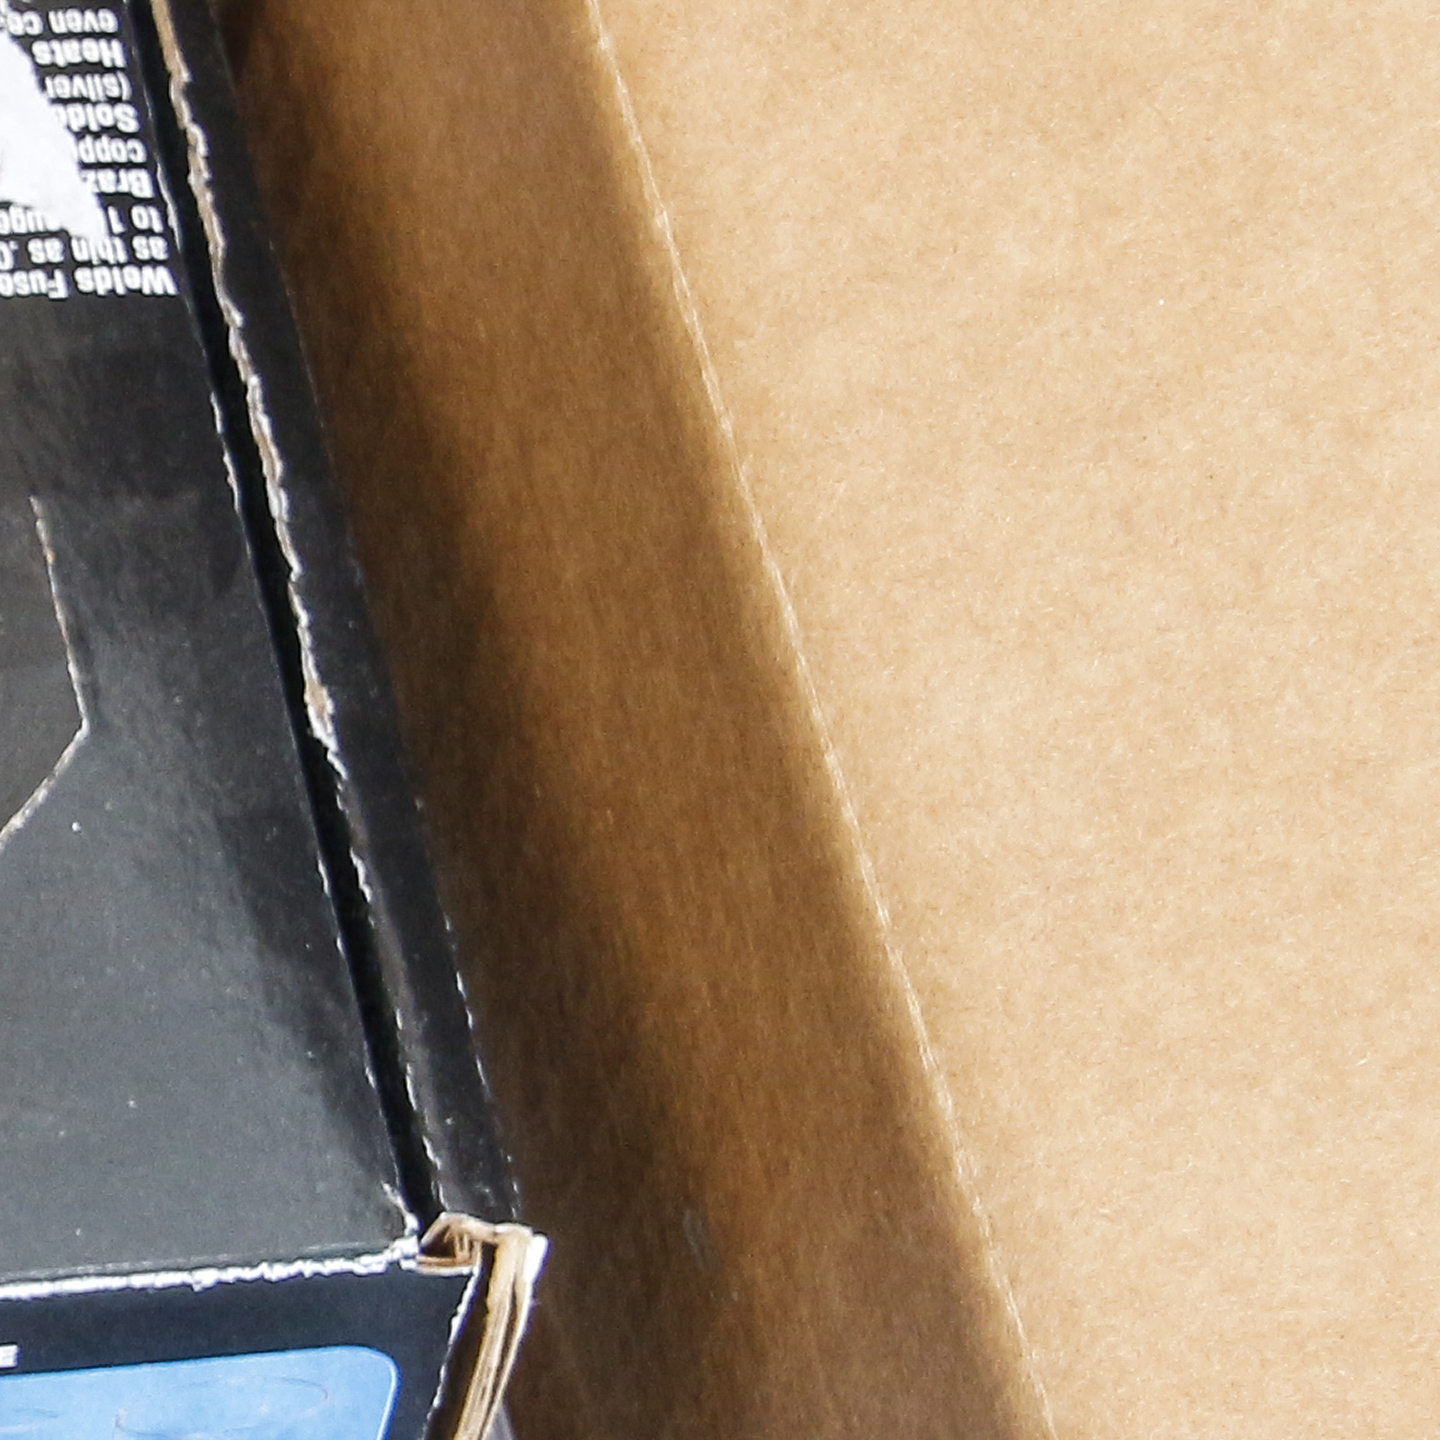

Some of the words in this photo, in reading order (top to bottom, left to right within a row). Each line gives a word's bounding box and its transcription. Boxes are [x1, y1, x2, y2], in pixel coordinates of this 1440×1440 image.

[47, 4, 117, 34] even
[30, 34, 124, 72] Heats
[74, 131, 146, 165] copp
[79, 166, 152, 200] Braz
[131, 205, 160, 232] to
[28, 236, 65, 263] as
[132, 234, 168, 260] as
[74, 262, 173, 298] Welds
